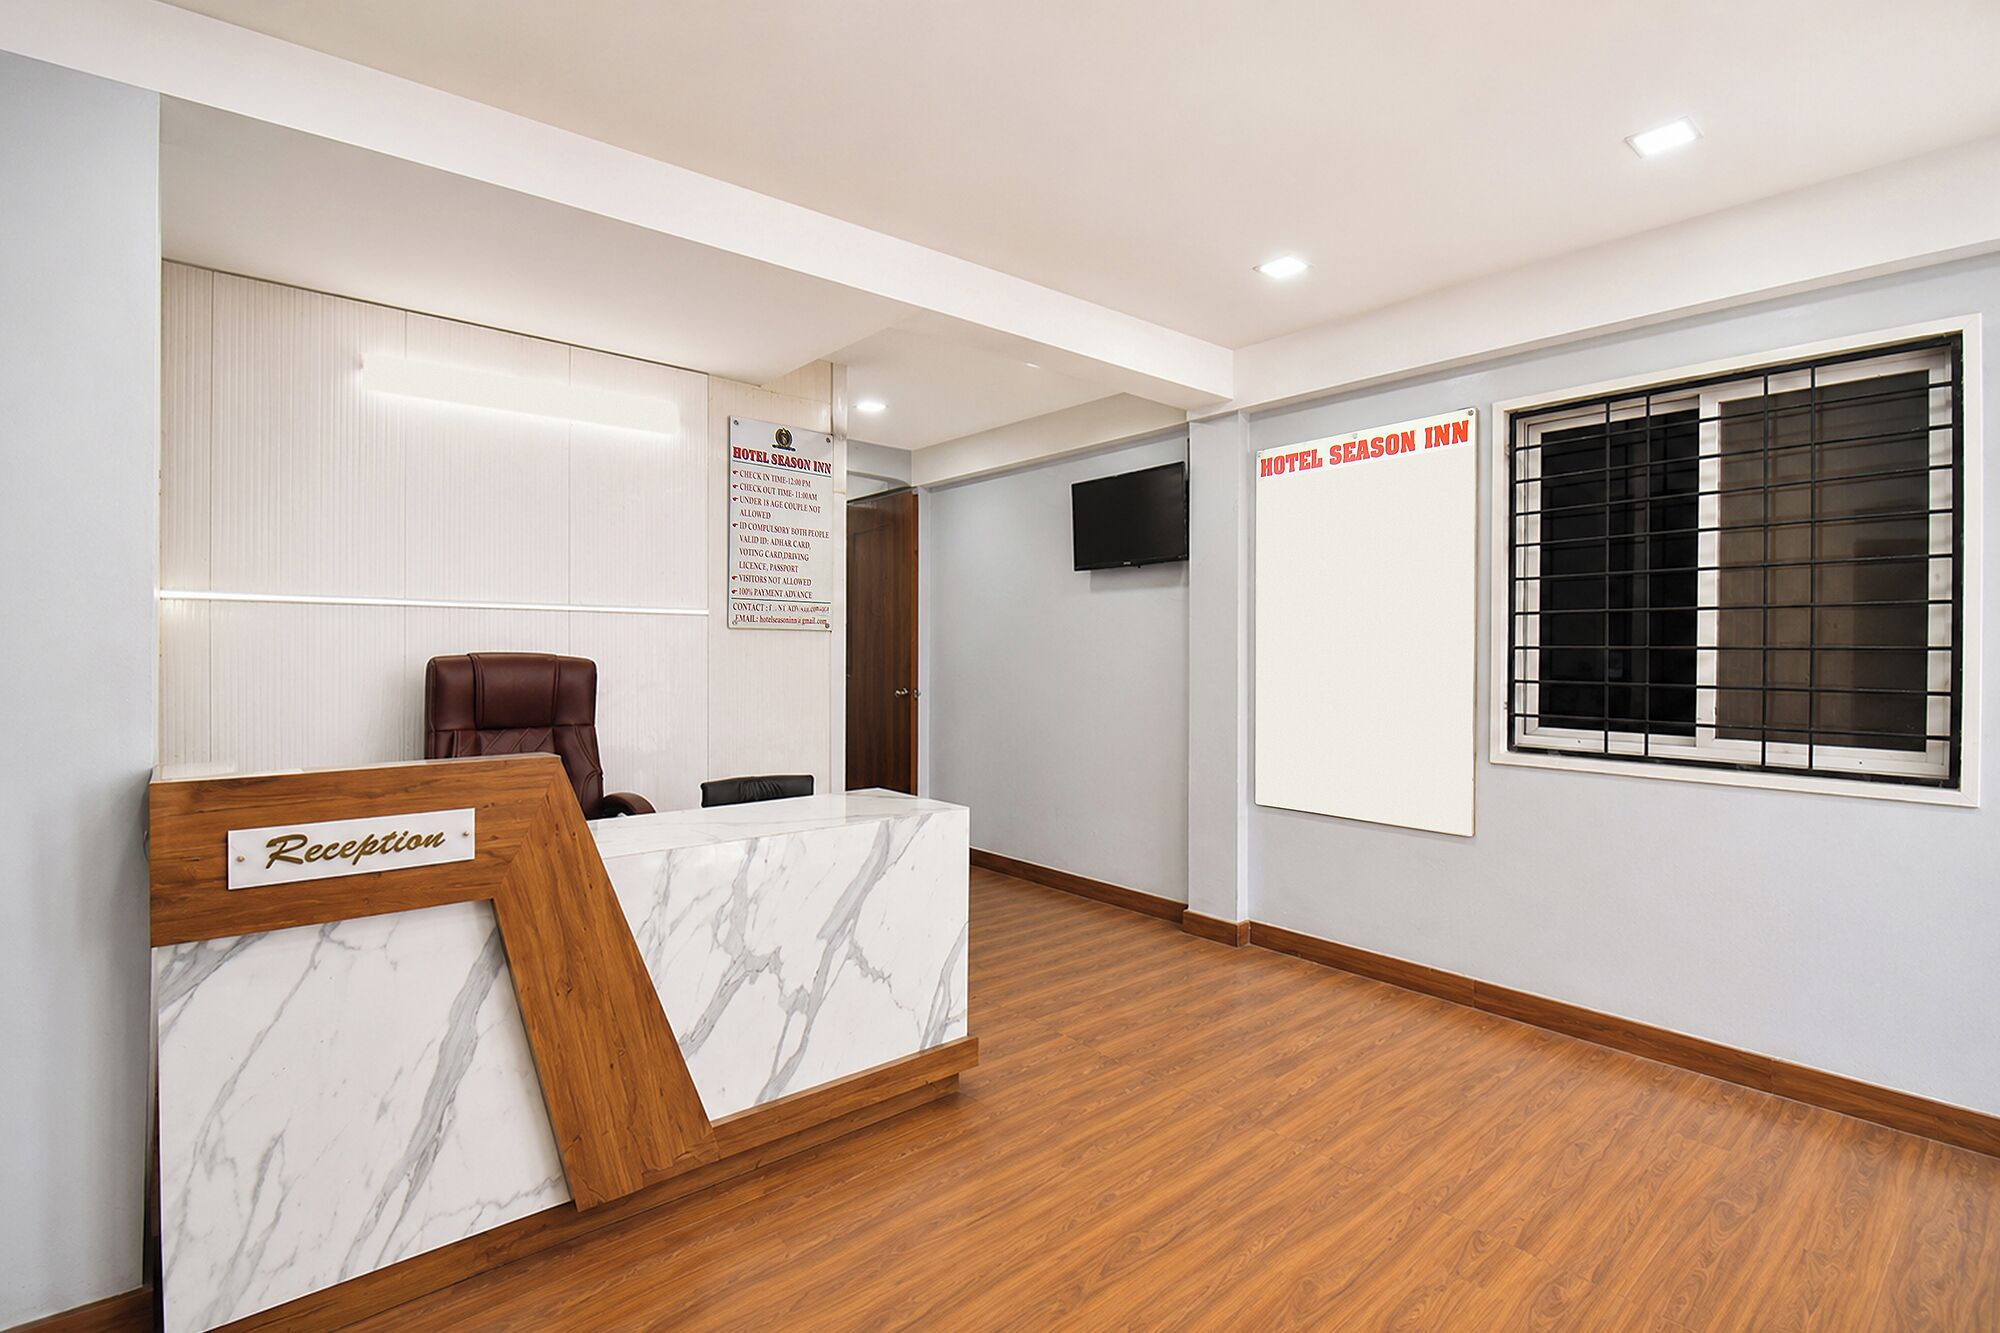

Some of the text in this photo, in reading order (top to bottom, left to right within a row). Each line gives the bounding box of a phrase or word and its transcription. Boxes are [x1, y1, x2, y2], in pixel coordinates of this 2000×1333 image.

[1260, 419, 1469, 478] HOTEL SEASON INN
[732, 446, 832, 474] HOTEL SEASON INN
[739, 469, 761, 479] CHECK
[762, 472, 770, 481] IN
[801, 479, 811, 488] PM
[739, 482, 762, 493] CHECK
[763, 486, 776, 495] OUT
[739, 495, 821, 514] UNDER 18 AGE COUPLE NOT
[739, 509, 771, 519] ALLOWED
[739, 521, 830, 539] ID COMPULSORY BOTH PEOPLE
[739, 534, 759, 544] VALID
[770, 538, 792, 548] ADHAR
[739, 547, 764, 558] VOTING
[739, 560, 798, 573] LICENCE, PASSPORT
[738, 574, 812, 587] VISITORS NOT ALLOWED
[738, 587, 813, 600] 100% PAYMENT ADVANCE
[265, 830, 446, 869] Reception
